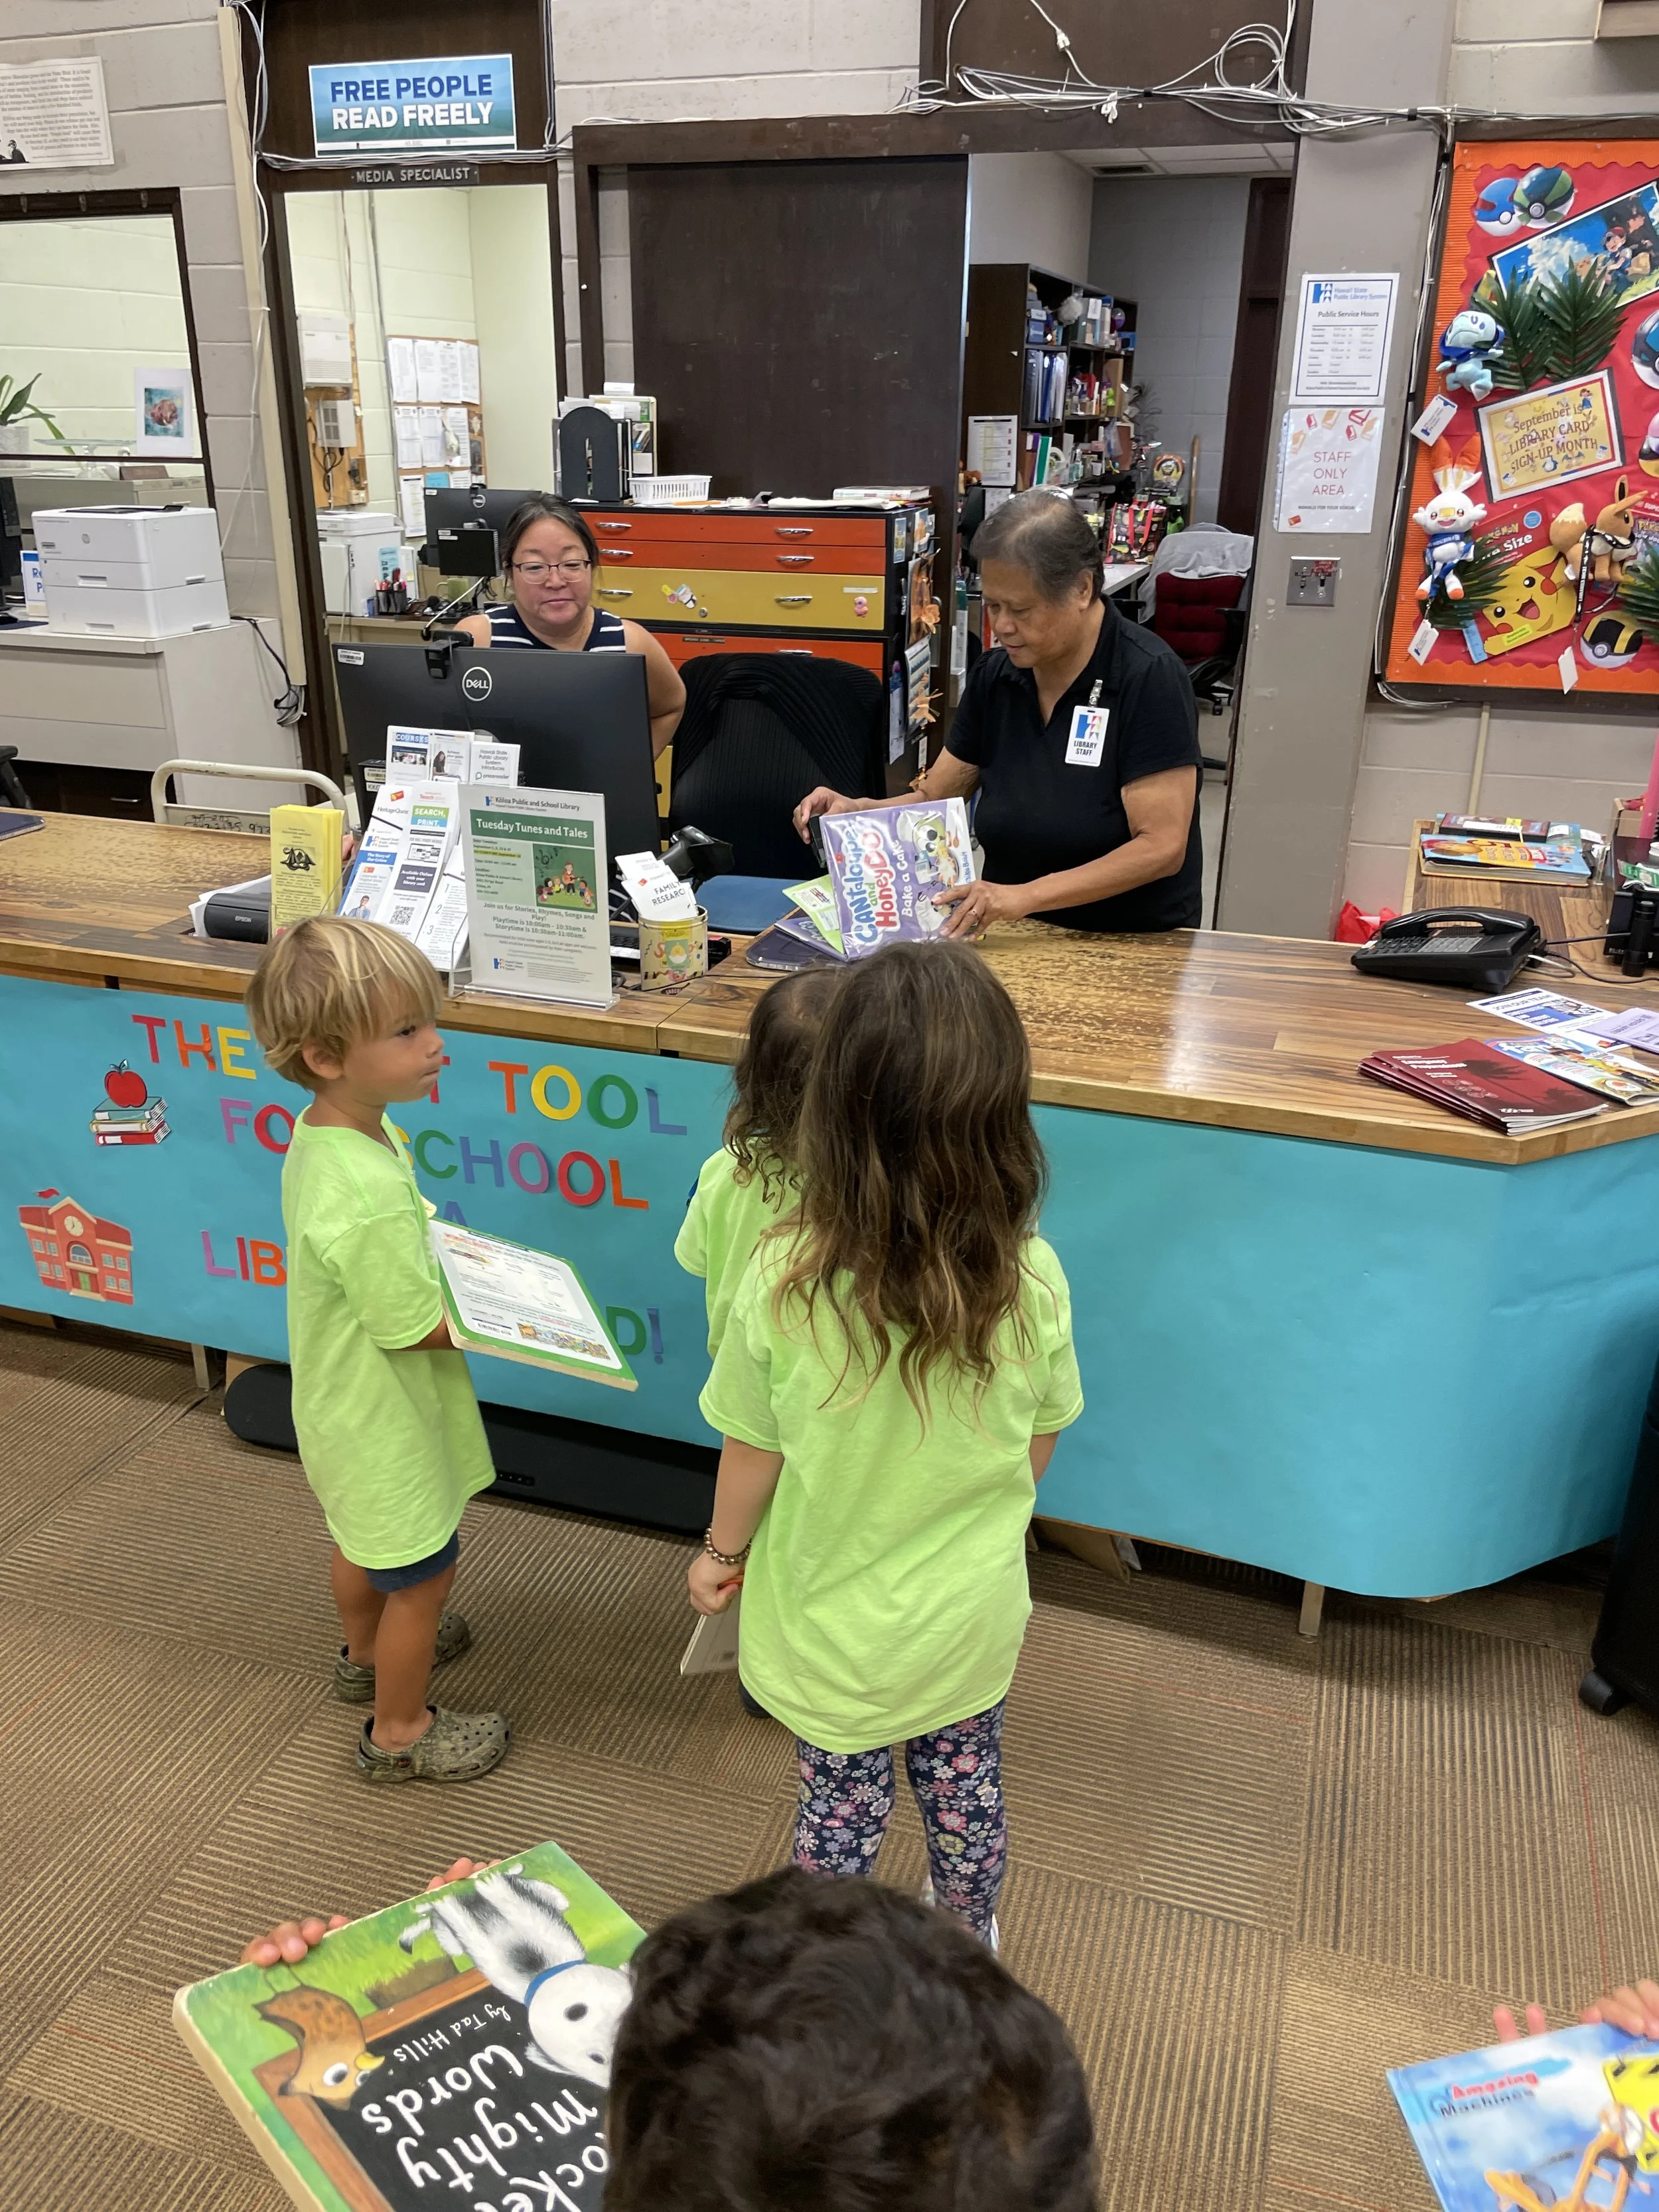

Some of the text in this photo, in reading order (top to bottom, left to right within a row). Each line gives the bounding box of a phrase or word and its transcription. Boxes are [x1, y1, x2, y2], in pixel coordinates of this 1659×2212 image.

[330, 74, 493, 103] FREE PEOPLE
[332, 102, 493, 130] READ FREELY
[356, 168, 470, 183] MEDIA SPECIALIST
[1513, 404, 1583, 433] September is
[1508, 420, 1590, 456] LIBRARY CARD
[1313, 451, 1352, 463] STAFF
[1510, 438, 1599, 475] SIGN-UP MONTH
[1313, 468, 1348, 479] ONLY
[1311, 484, 1345, 496] AREA
[1503, 534, 1533, 552] Size
[466, 678, 489, 689] DELL
[396, 733, 428, 744] COURSES
[1074, 740, 1098, 749] LIBRARY
[415, 808, 446, 817] SEARCH,
[560, 802, 580, 811] Library
[476, 818, 588, 838] Tuesday Tunes and Tales
[892, 840, 912, 917] Bake a Cake
[654, 881, 680, 895] FAMILY
[865, 882, 878, 907] and
[435, 904, 443, 915] 2
[514, 906, 537, 915] Stories,
[538, 908, 564, 918] Rhymes,
[565, 912, 583, 921] Songs
[493, 917, 519, 925] Playtime
[495, 924, 524, 933] Storytime
[427, 924, 434, 935] 3
[131, 1014, 257, 1080] THE
[488, 1061, 687, 1136] TOOL
[220, 1097, 295, 1154] FO
[393, 2003, 511, 2062] by Tad Hills
[361, 2044, 524, 2136] Words
[1452, 2071, 1540, 2100] Amazing
[396, 2089, 598, 2192] Mighty
